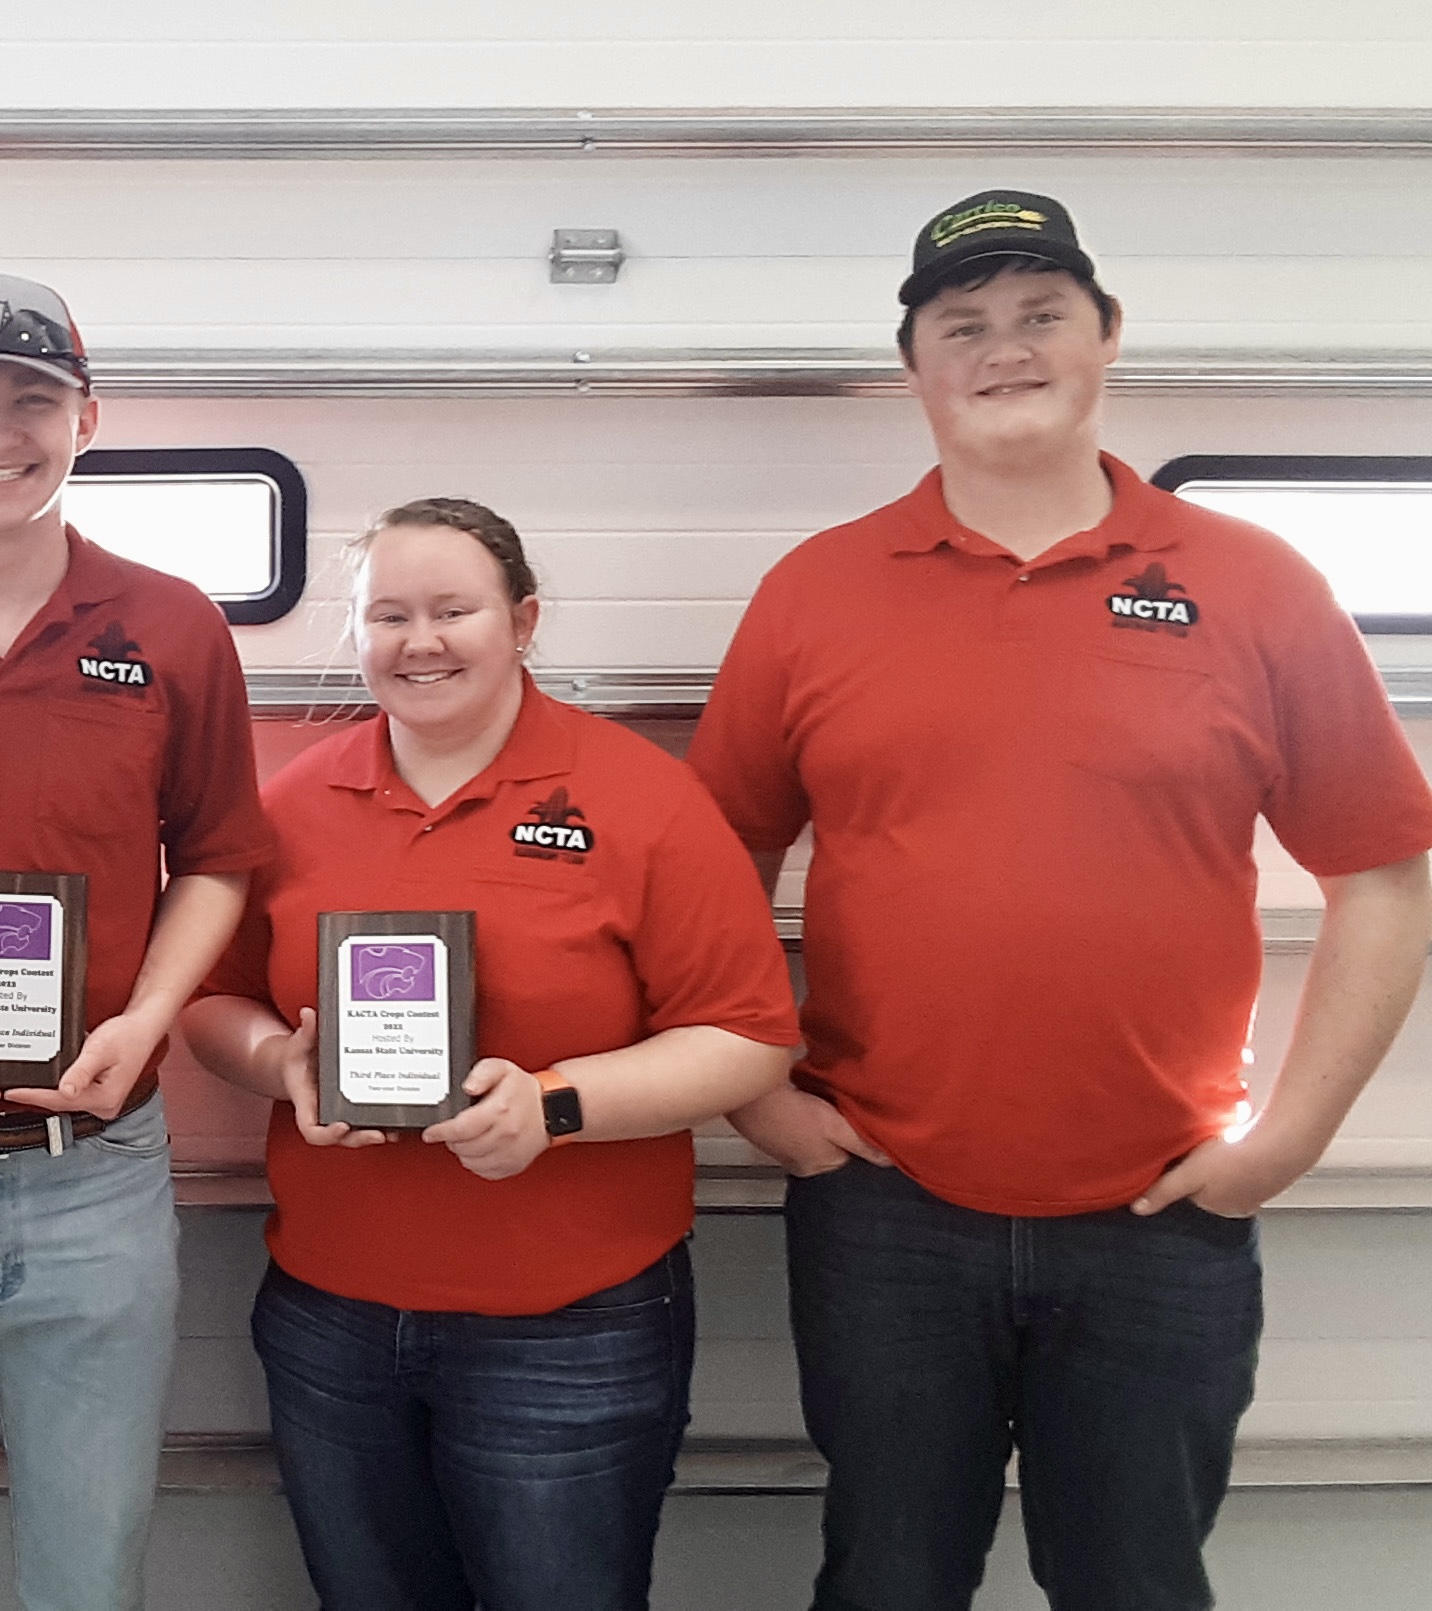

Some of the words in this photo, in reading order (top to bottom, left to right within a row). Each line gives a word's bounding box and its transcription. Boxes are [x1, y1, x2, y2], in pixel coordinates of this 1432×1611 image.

[1111, 597, 1190, 623] NCTA
[80, 658, 145, 684] NCTA
[515, 826, 586, 849] NCTA
[17, 992, 27, 1001] By
[12, 1004, 57, 1014] University
[347, 1010, 378, 1018] KACTA
[380, 1010, 405, 1019] Crops
[407, 1010, 439, 1018] Contest
[12, 1029, 55, 1037] Individual
[372, 1034, 401, 1042] Hosted
[404, 1034, 414, 1043] By
[399, 1047, 443, 1056] University
[350, 1071, 371, 1079] Third
